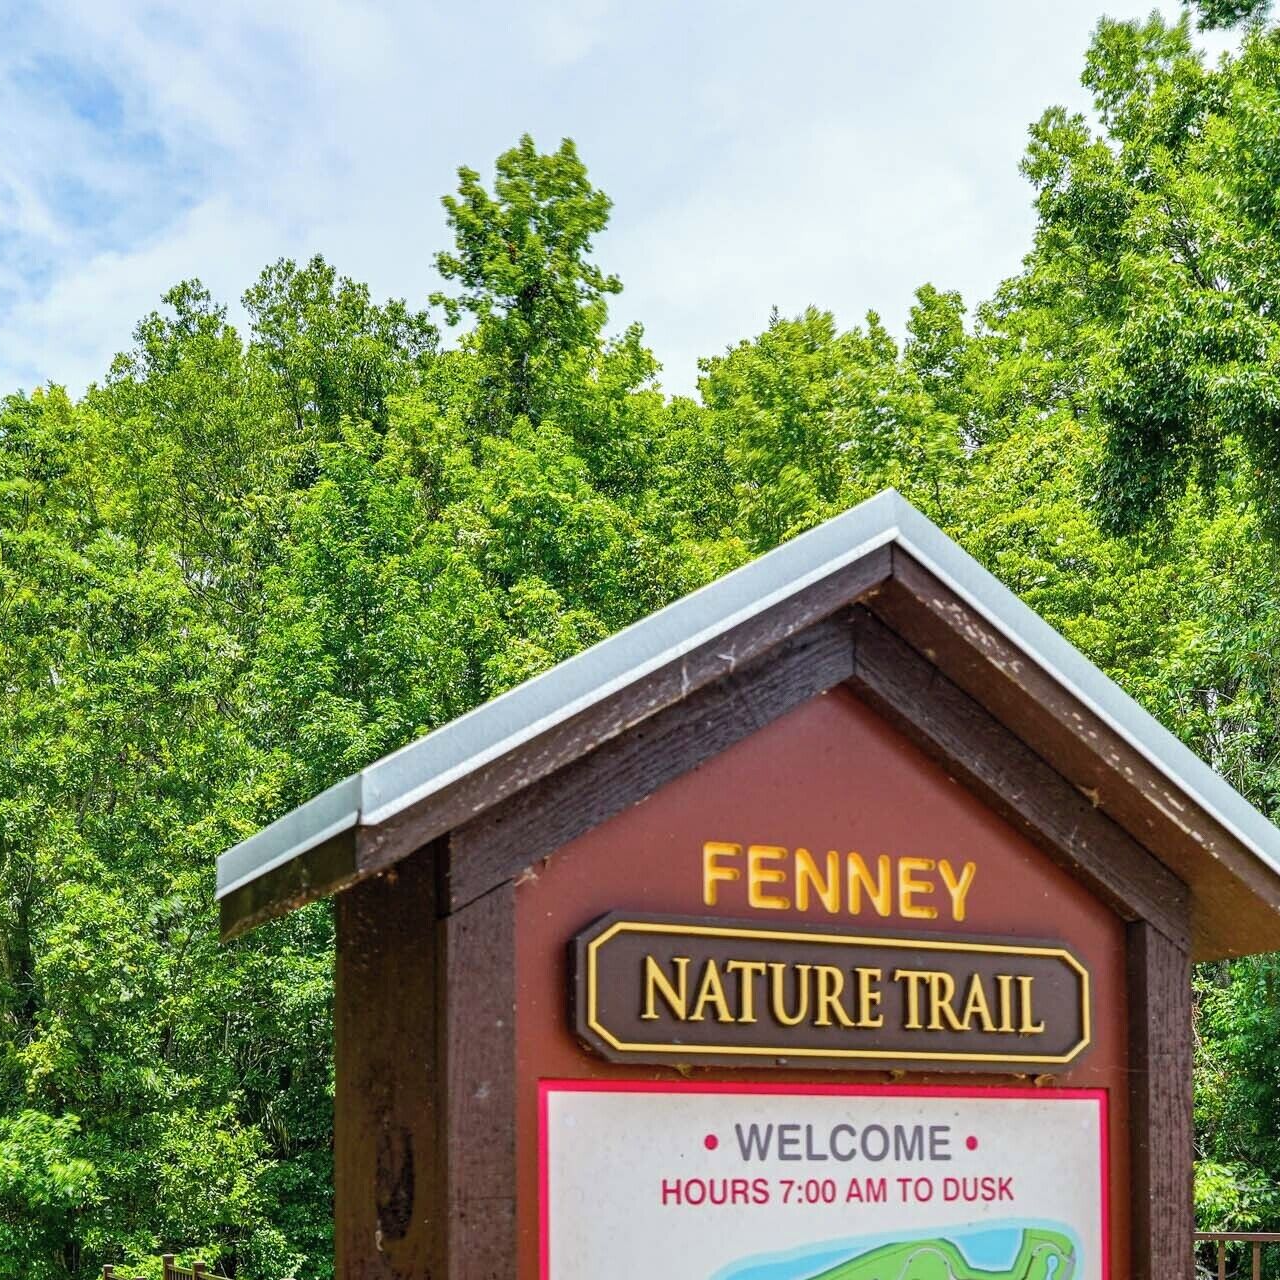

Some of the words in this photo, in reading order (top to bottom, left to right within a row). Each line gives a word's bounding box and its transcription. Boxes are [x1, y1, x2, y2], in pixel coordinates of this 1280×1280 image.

[703, 841, 977, 922] FENNEY
[641, 955, 883, 1029] NATURE
[895, 968, 1045, 1035] TRAIL
[734, 1123, 952, 1163] WELCOME
[661, 1178, 769, 1206] HOURS
[779, 1178, 837, 1204] 7:00
[845, 1178, 888, 1203] AM
[896, 1177, 933, 1202] TO
[943, 1176, 1015, 1202] DUSK
